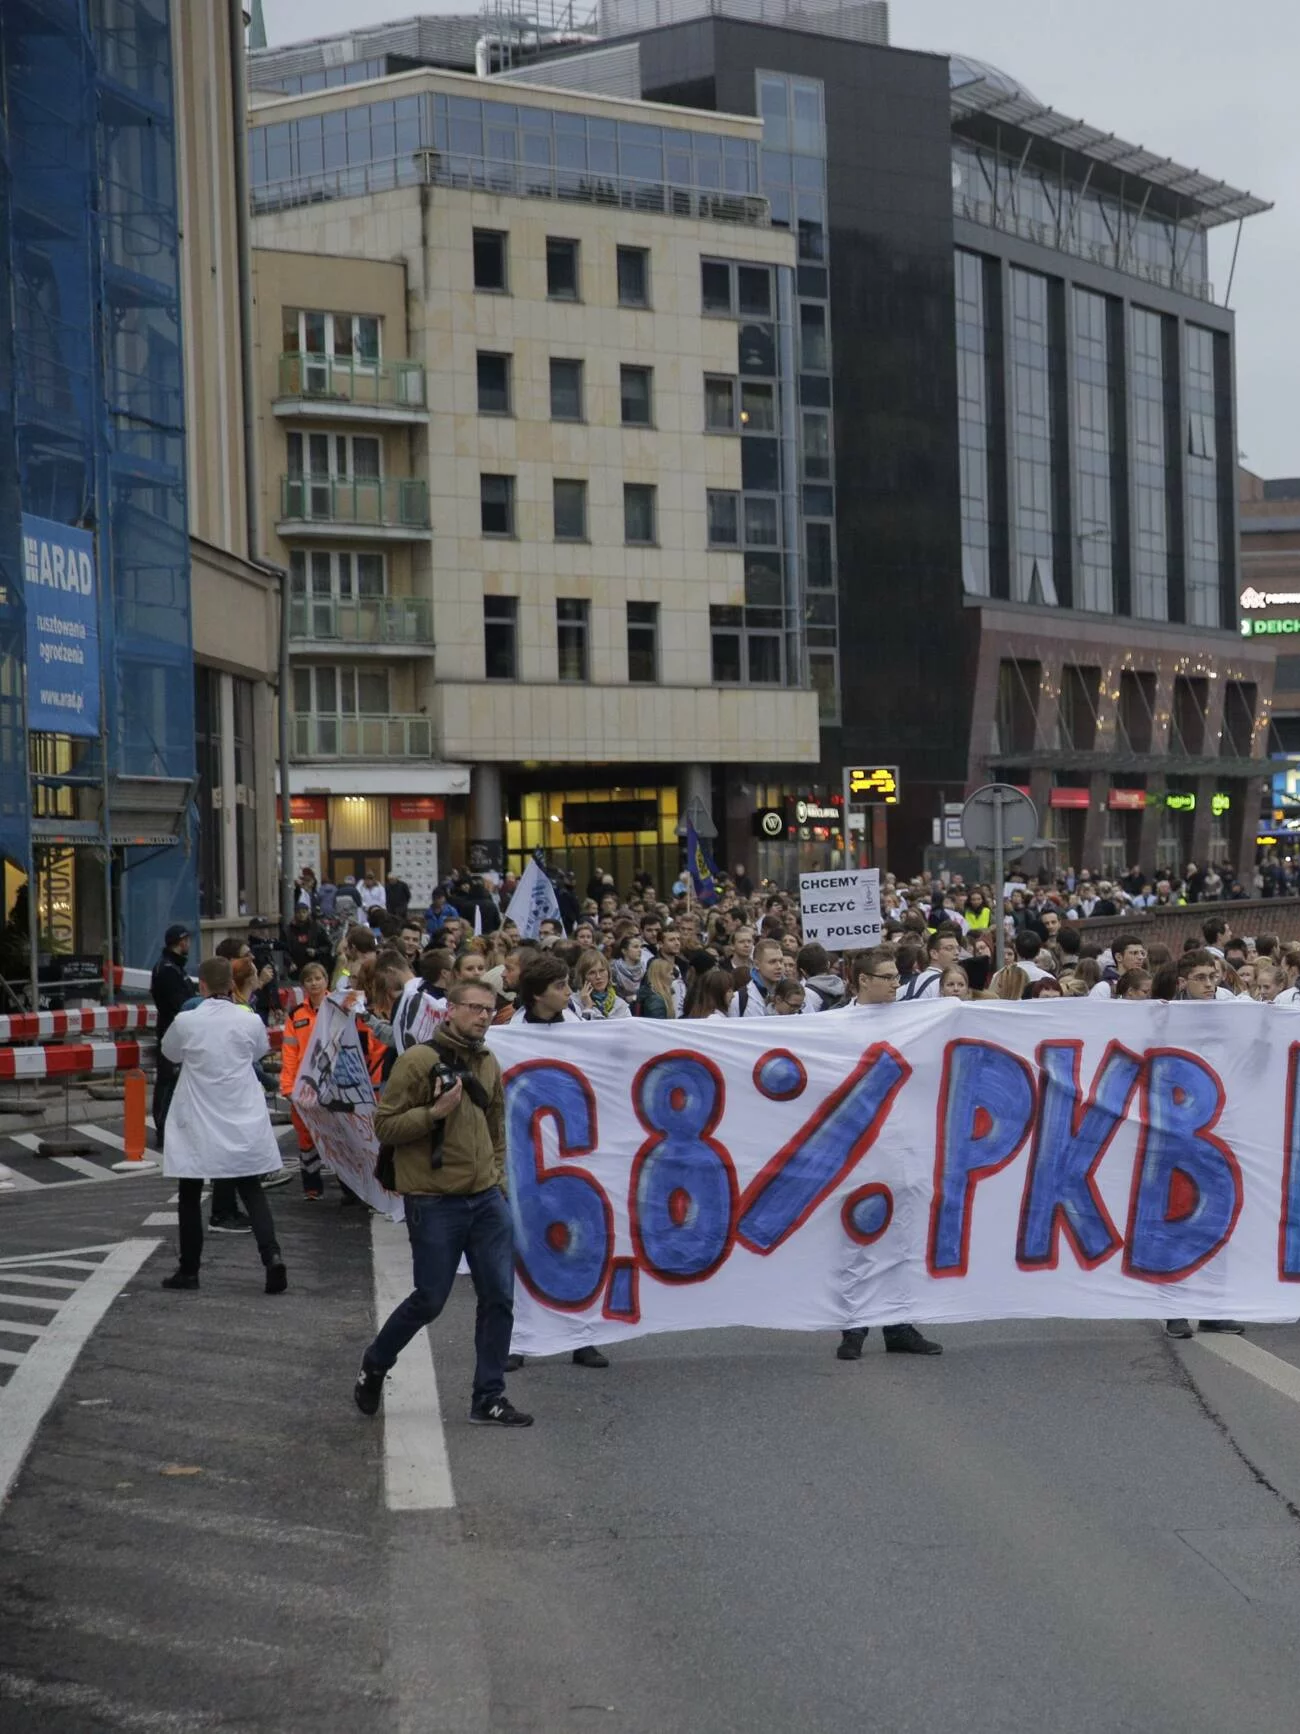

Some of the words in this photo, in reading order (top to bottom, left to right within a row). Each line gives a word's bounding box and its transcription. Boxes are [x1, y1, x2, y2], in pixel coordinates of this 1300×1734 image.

[40, 541, 93, 596] ARAD
[36, 614, 87, 639] rusztowania
[39, 641, 85, 665] ogrodzenia
[39, 688, 84, 713] www.arad.pl
[801, 876, 858, 890] CHCEMY
[802, 899, 856, 914] LECZYĆ
[806, 928, 819, 938] W
[827, 923, 881, 937] POLSCE
[503, 1041, 912, 1324] 6,8%
[926, 1037, 1244, 1283] PKB
